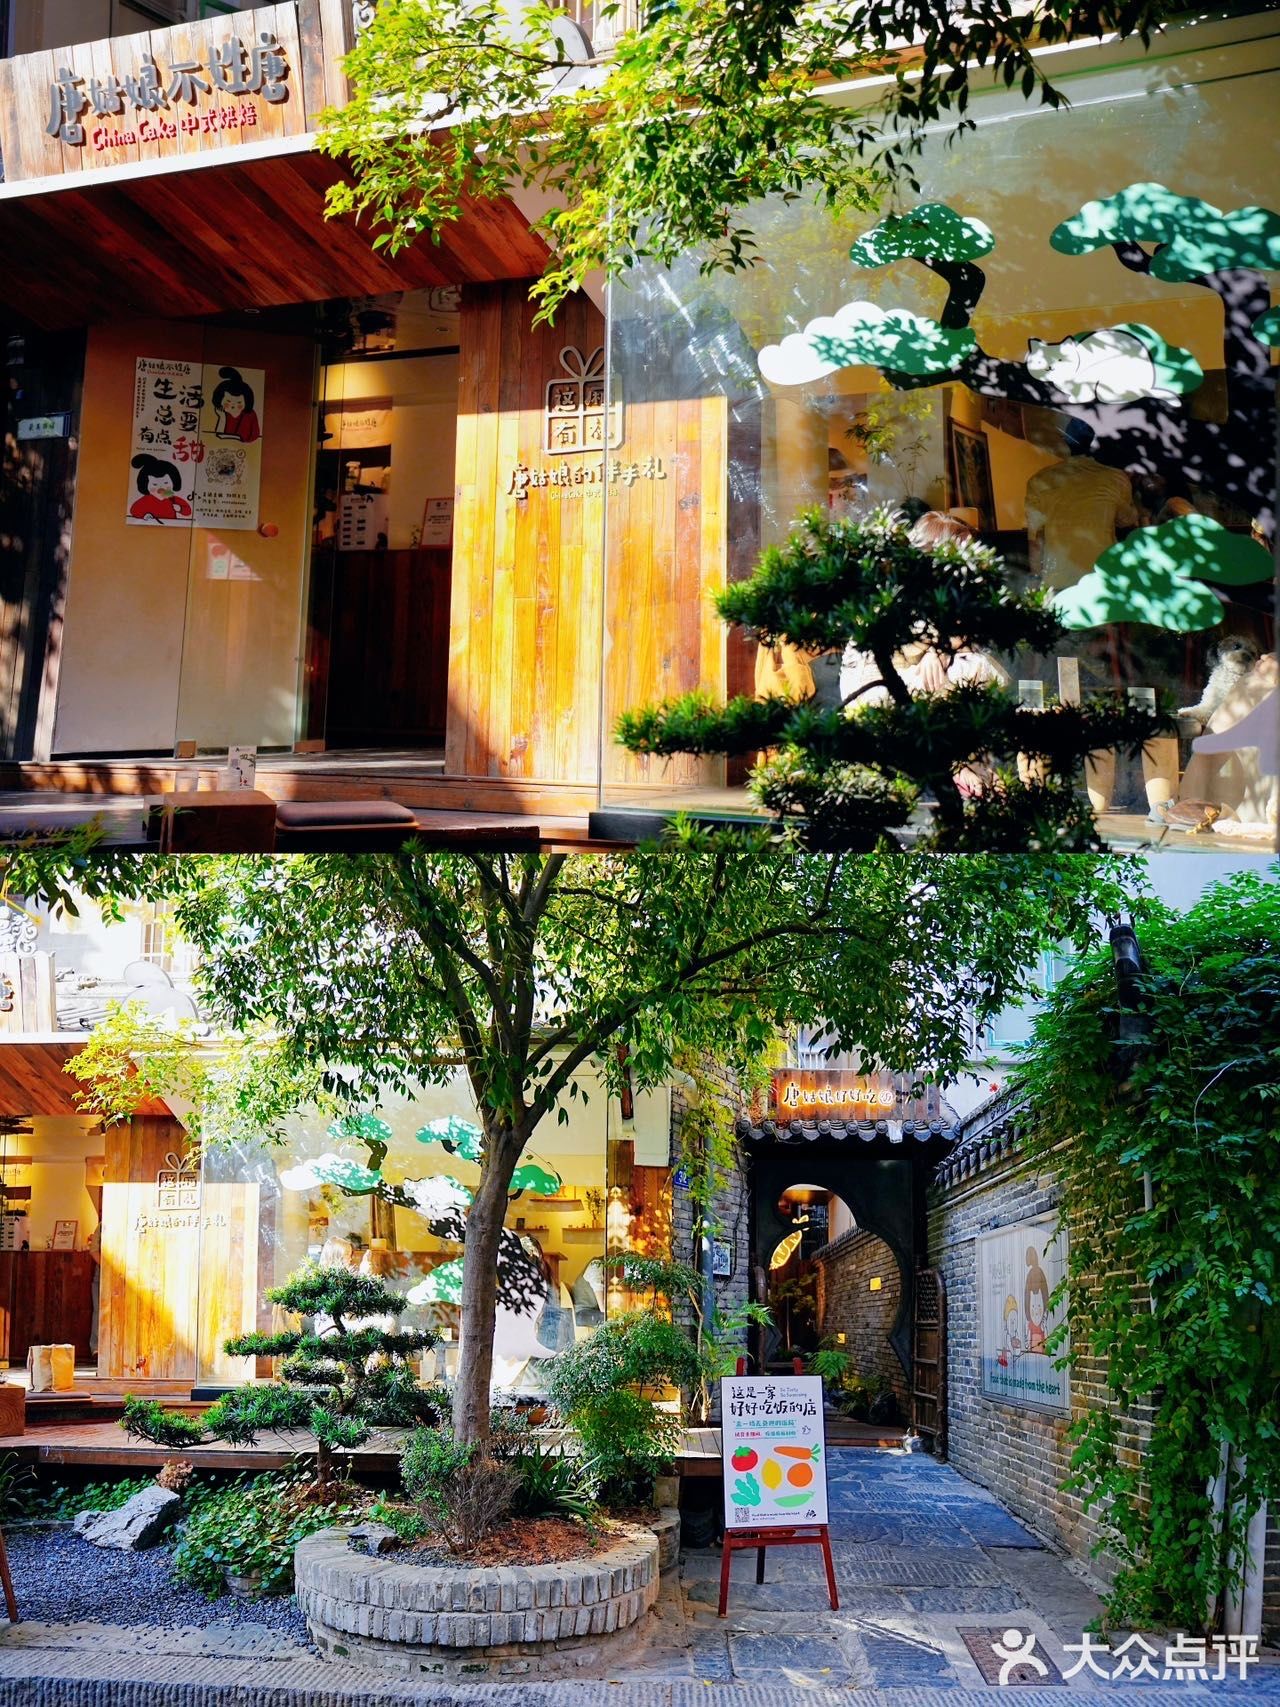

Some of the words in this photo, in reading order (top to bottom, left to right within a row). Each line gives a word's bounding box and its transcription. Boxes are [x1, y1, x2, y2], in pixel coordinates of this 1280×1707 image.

[46, 32, 288, 146] 唐姑娘不姓唐
[93, 127, 135, 150] China
[139, 117, 176, 141] Cake
[181, 102, 257, 136] 中式烘焙
[153, 377, 205, 409] 生活
[155, 405, 198, 433] 总要
[507, 455, 667, 499] 唐姑娘的伴手礼
[730, 1399, 816, 1416] 好好吃饭的店
[732, 1384, 776, 1400] 这是一家
